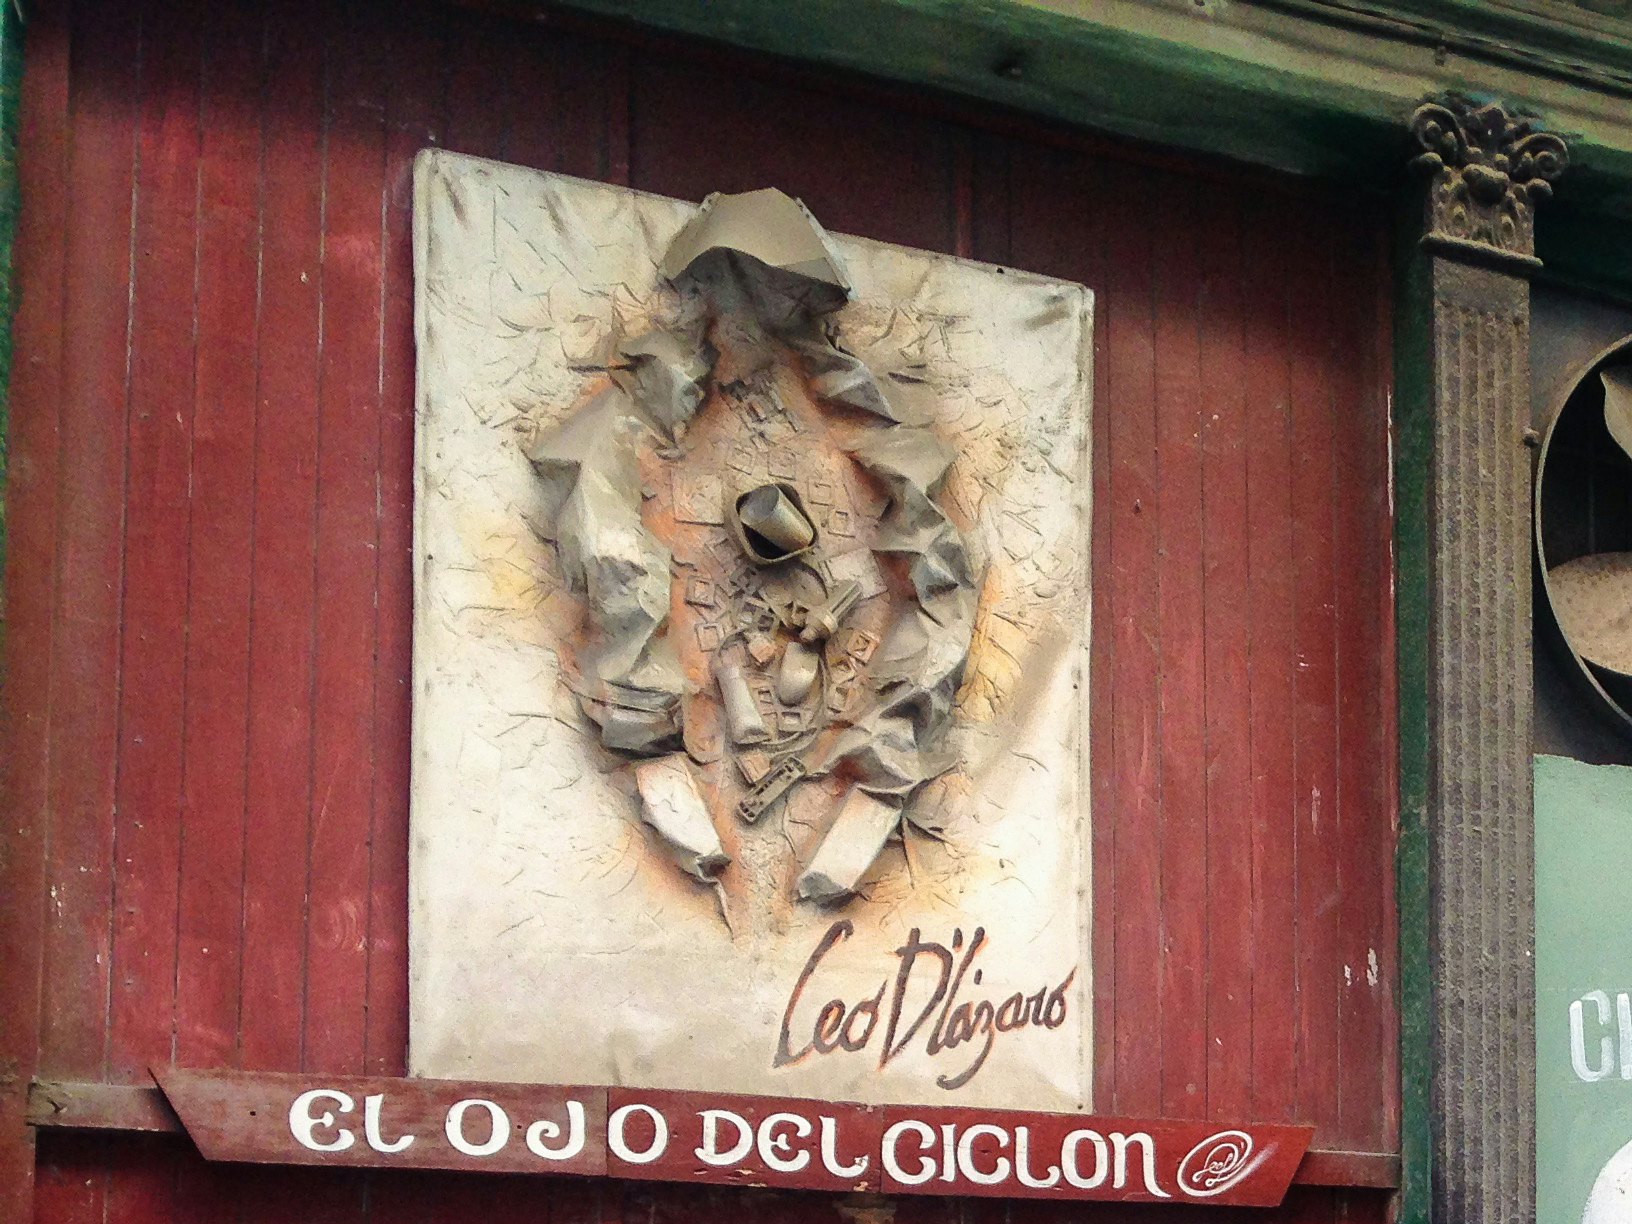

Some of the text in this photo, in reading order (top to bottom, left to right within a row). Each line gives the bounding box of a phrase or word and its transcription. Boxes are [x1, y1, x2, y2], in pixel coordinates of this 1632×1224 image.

[773, 919, 887, 1069] Leo
[289, 1089, 415, 1153] EL
[445, 1099, 668, 1164] OJO
[694, 1109, 869, 1177] DEL
